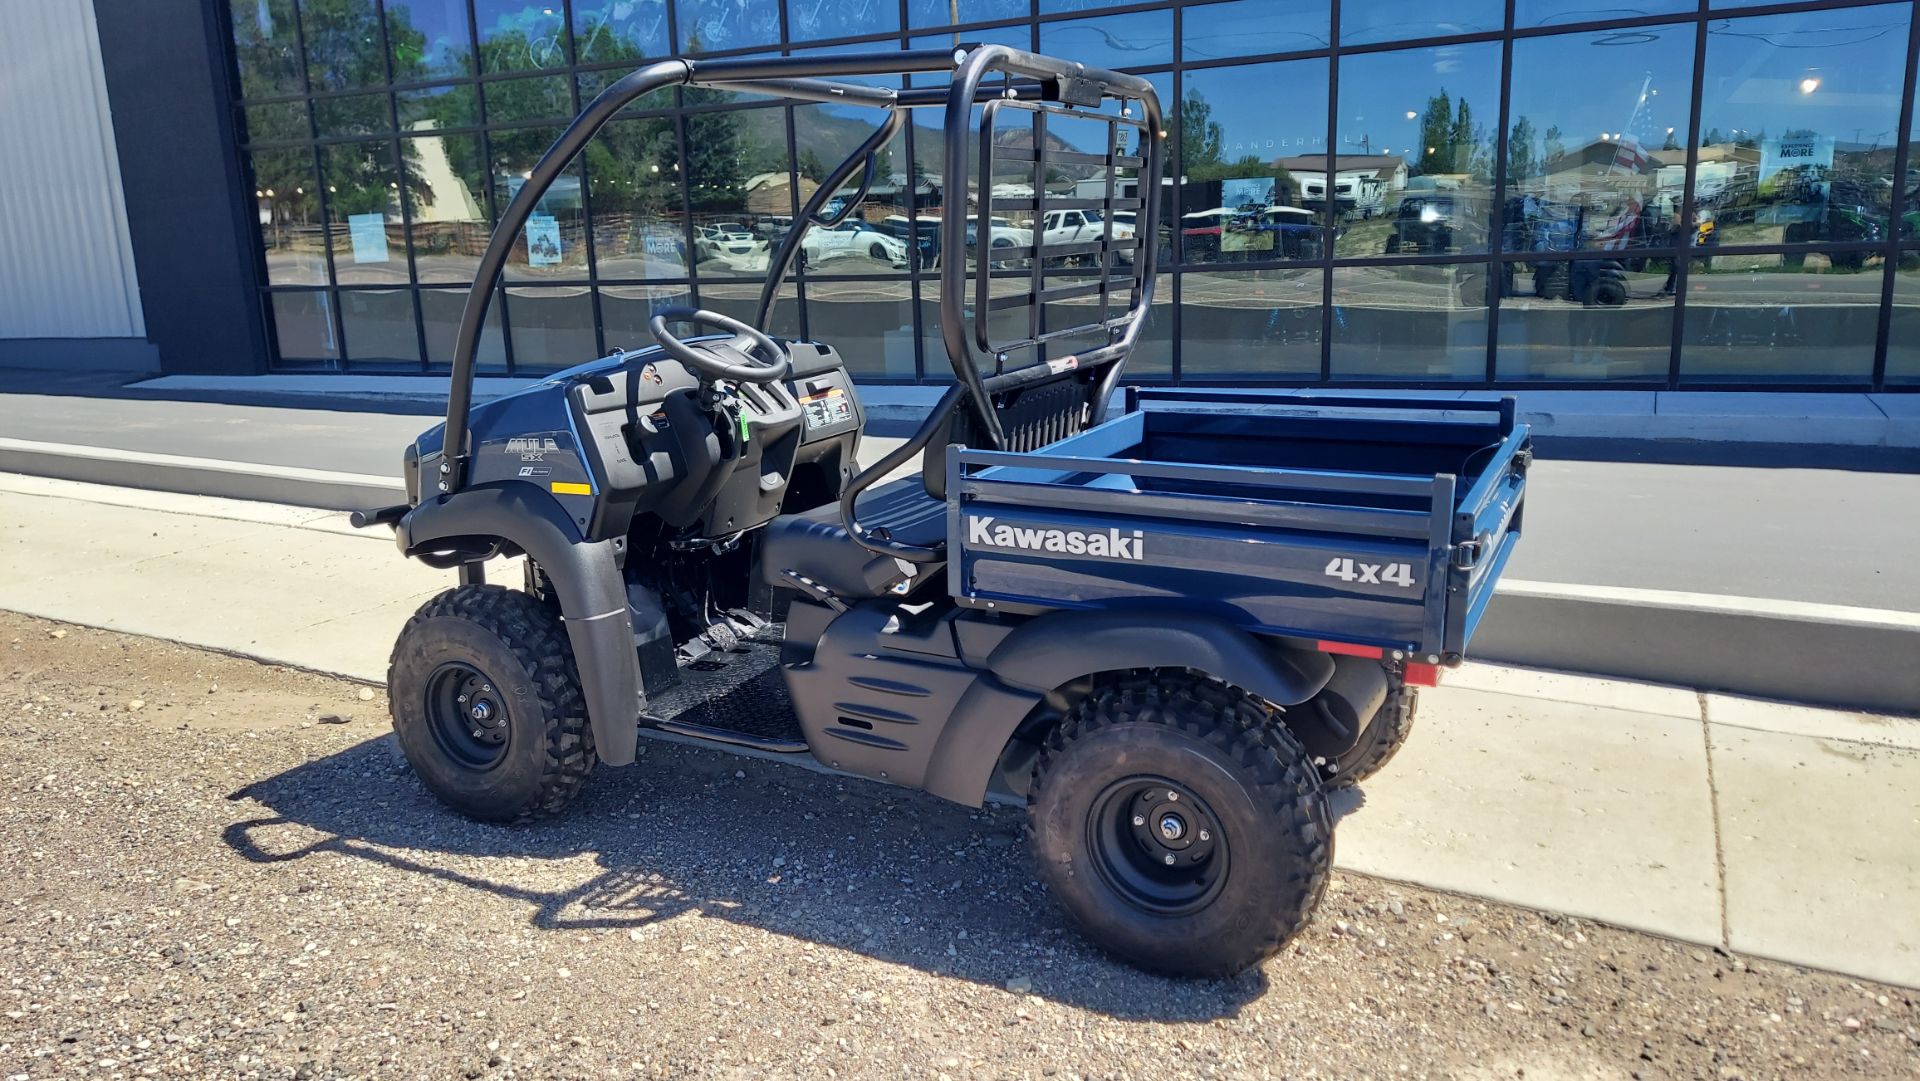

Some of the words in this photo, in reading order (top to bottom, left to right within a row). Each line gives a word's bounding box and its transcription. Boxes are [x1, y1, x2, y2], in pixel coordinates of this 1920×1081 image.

[1222, 133, 1367, 151] VANDERHLL
[1780, 148, 1815, 158] MORE
[646, 241, 676, 254] MORE
[504, 438, 560, 453] MULE
[521, 453, 544, 461] SX
[969, 515, 1143, 560] Kawasaki
[1325, 557, 1416, 588] 4x4
